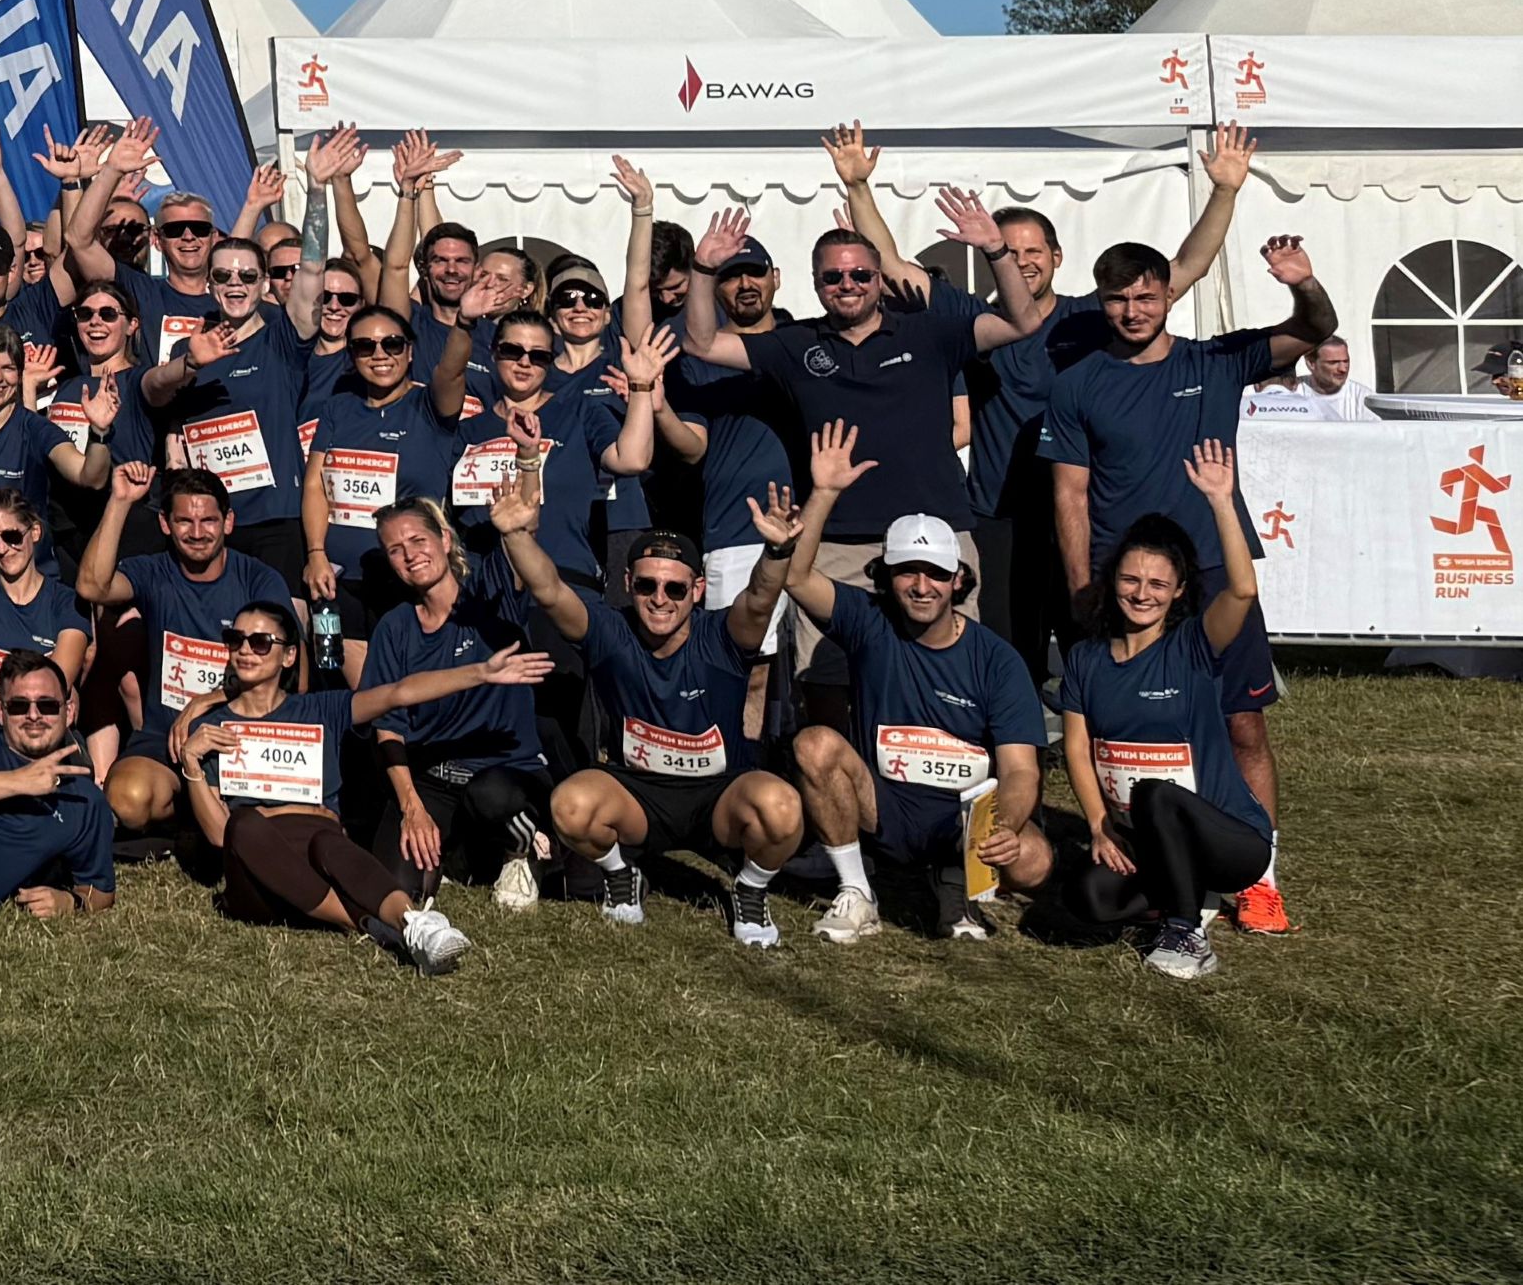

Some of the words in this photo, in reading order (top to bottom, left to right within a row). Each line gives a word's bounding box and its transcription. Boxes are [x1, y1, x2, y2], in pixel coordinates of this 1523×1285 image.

[705, 81, 815, 100] BAWAG
[213, 441, 254, 462] 364A
[343, 478, 382, 495] 356A
[1434, 573, 1515, 585] BUSINESS
[1435, 587, 1469, 599] RUN
[648, 730, 677, 744] WIEN
[260, 747, 307, 765] 400A
[662, 754, 711, 769] 341B
[1112, 750, 1139, 760] WIEN
[1139, 750, 1185, 762] ENERGIE
[921, 759, 972, 778] 357B
